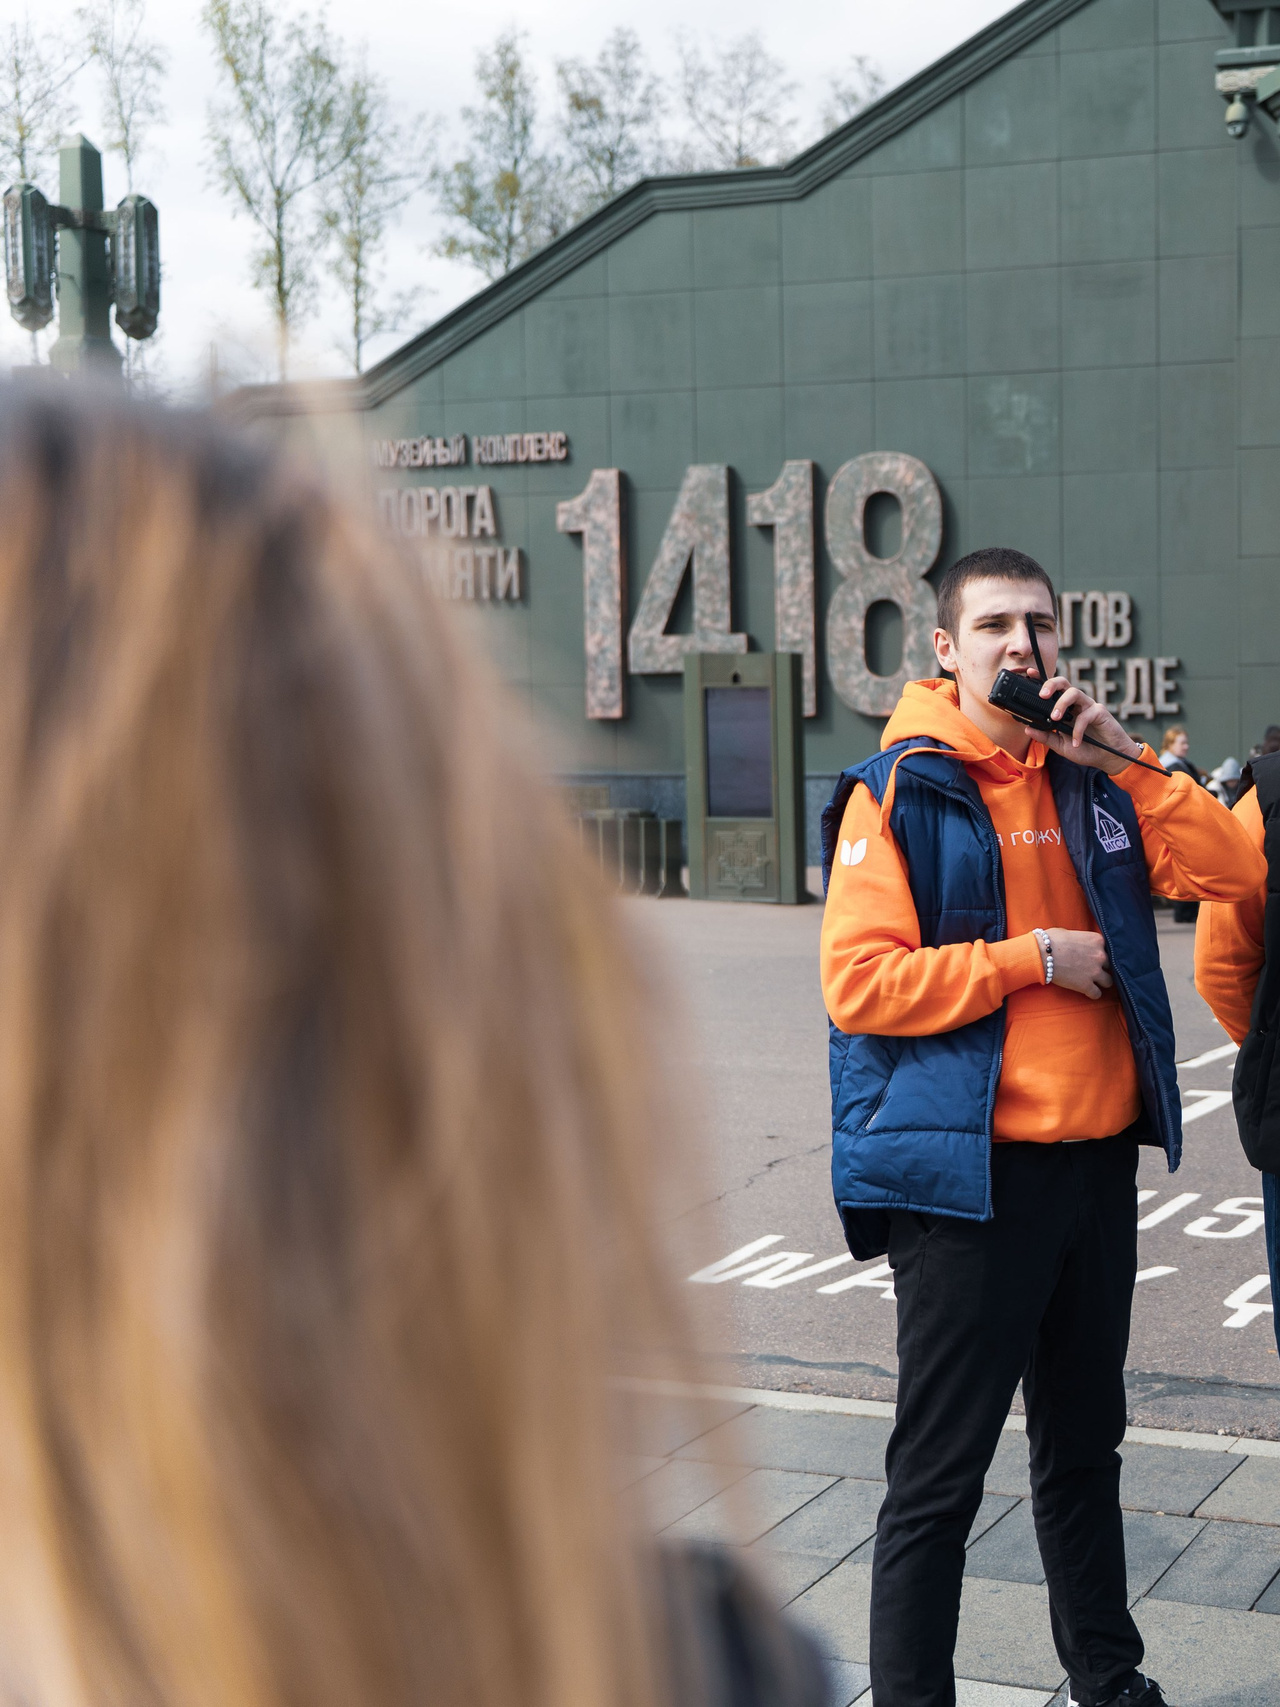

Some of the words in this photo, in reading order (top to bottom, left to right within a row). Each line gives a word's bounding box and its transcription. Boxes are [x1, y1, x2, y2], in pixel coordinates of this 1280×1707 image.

[473, 432, 567, 464] КОМПЛЕКС
[556, 451, 945, 720] 1418
[1057, 590, 1133, 648] ГОВ
[1104, 836, 1127, 852] МГСУ
